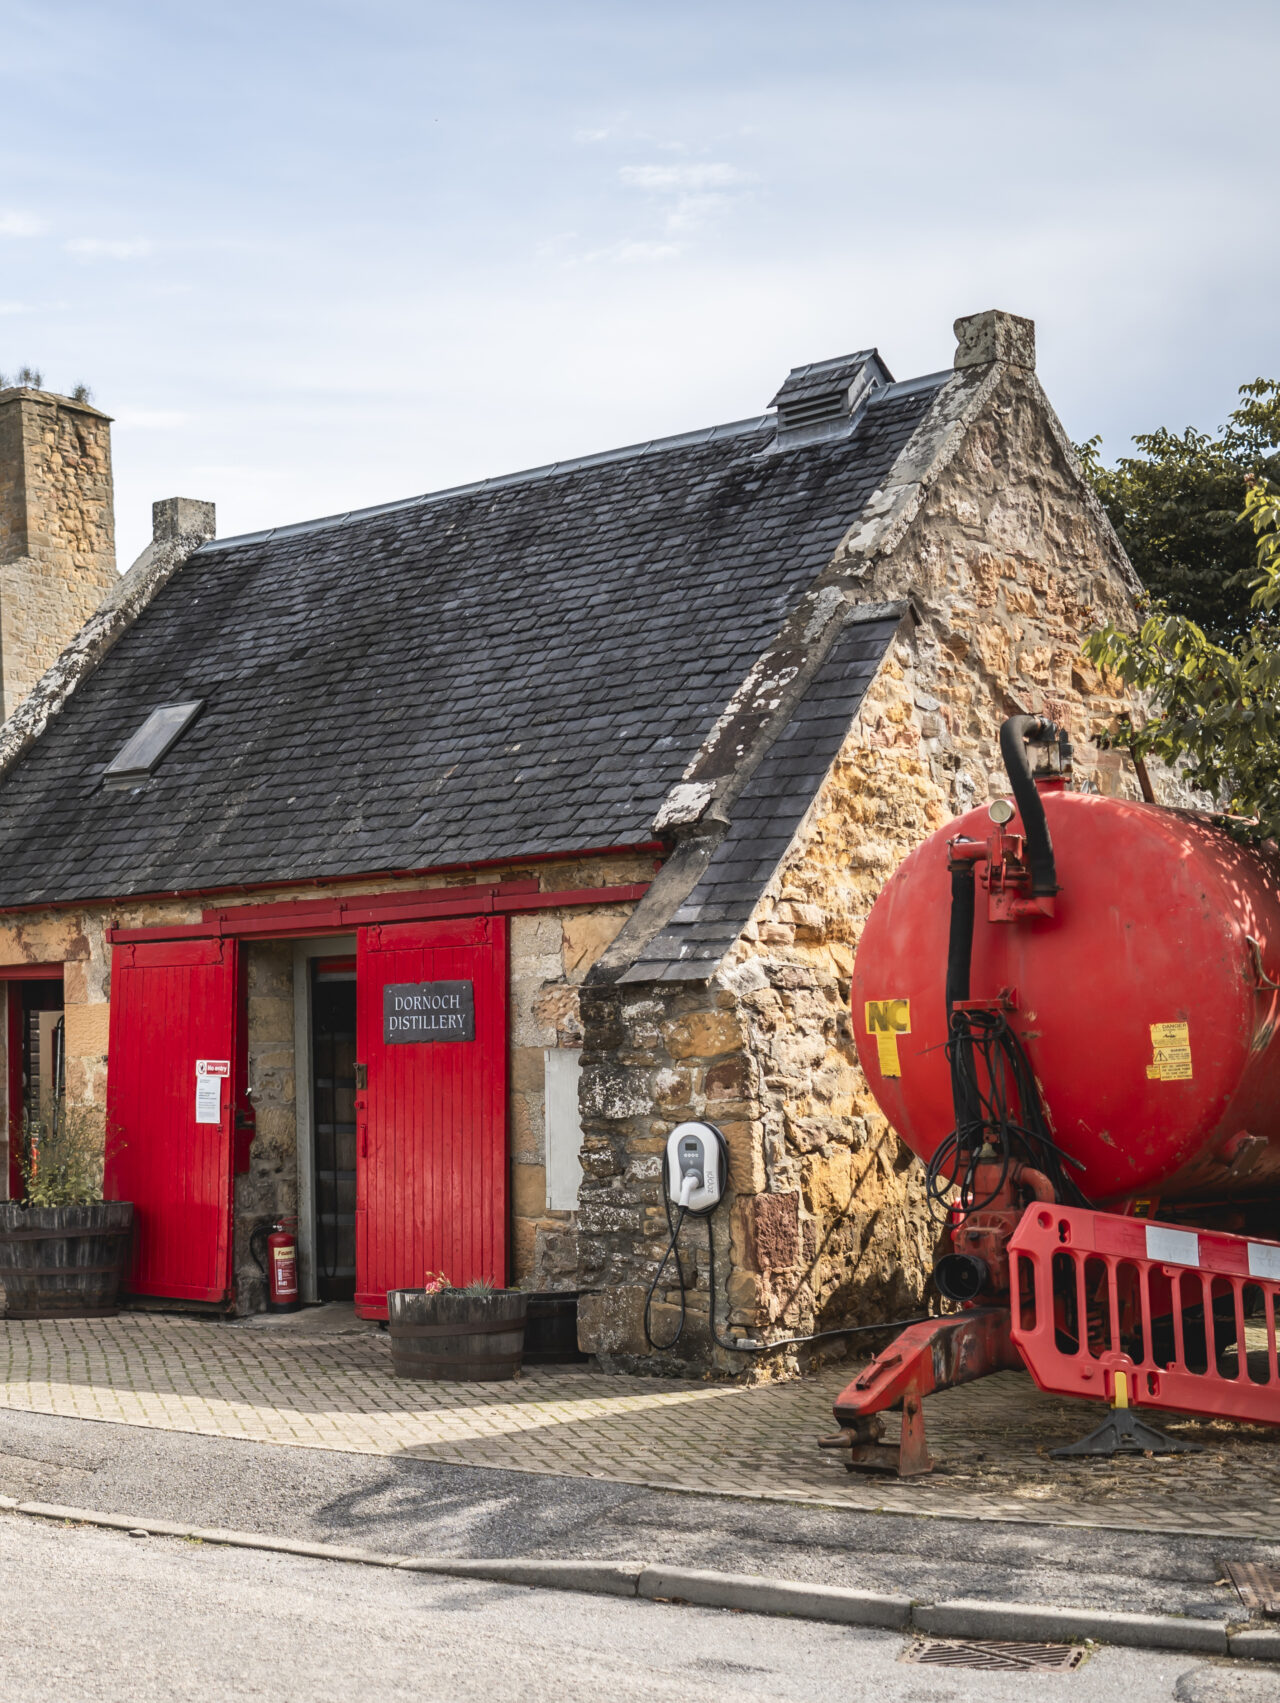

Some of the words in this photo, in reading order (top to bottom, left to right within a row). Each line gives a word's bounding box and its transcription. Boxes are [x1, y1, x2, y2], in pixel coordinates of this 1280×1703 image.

[395, 994, 460, 1010] DORNOCH
[389, 1014, 466, 1030] DISTILLERY
[869, 1000, 908, 1032] NC
[706, 1170, 714, 1194] zappi
